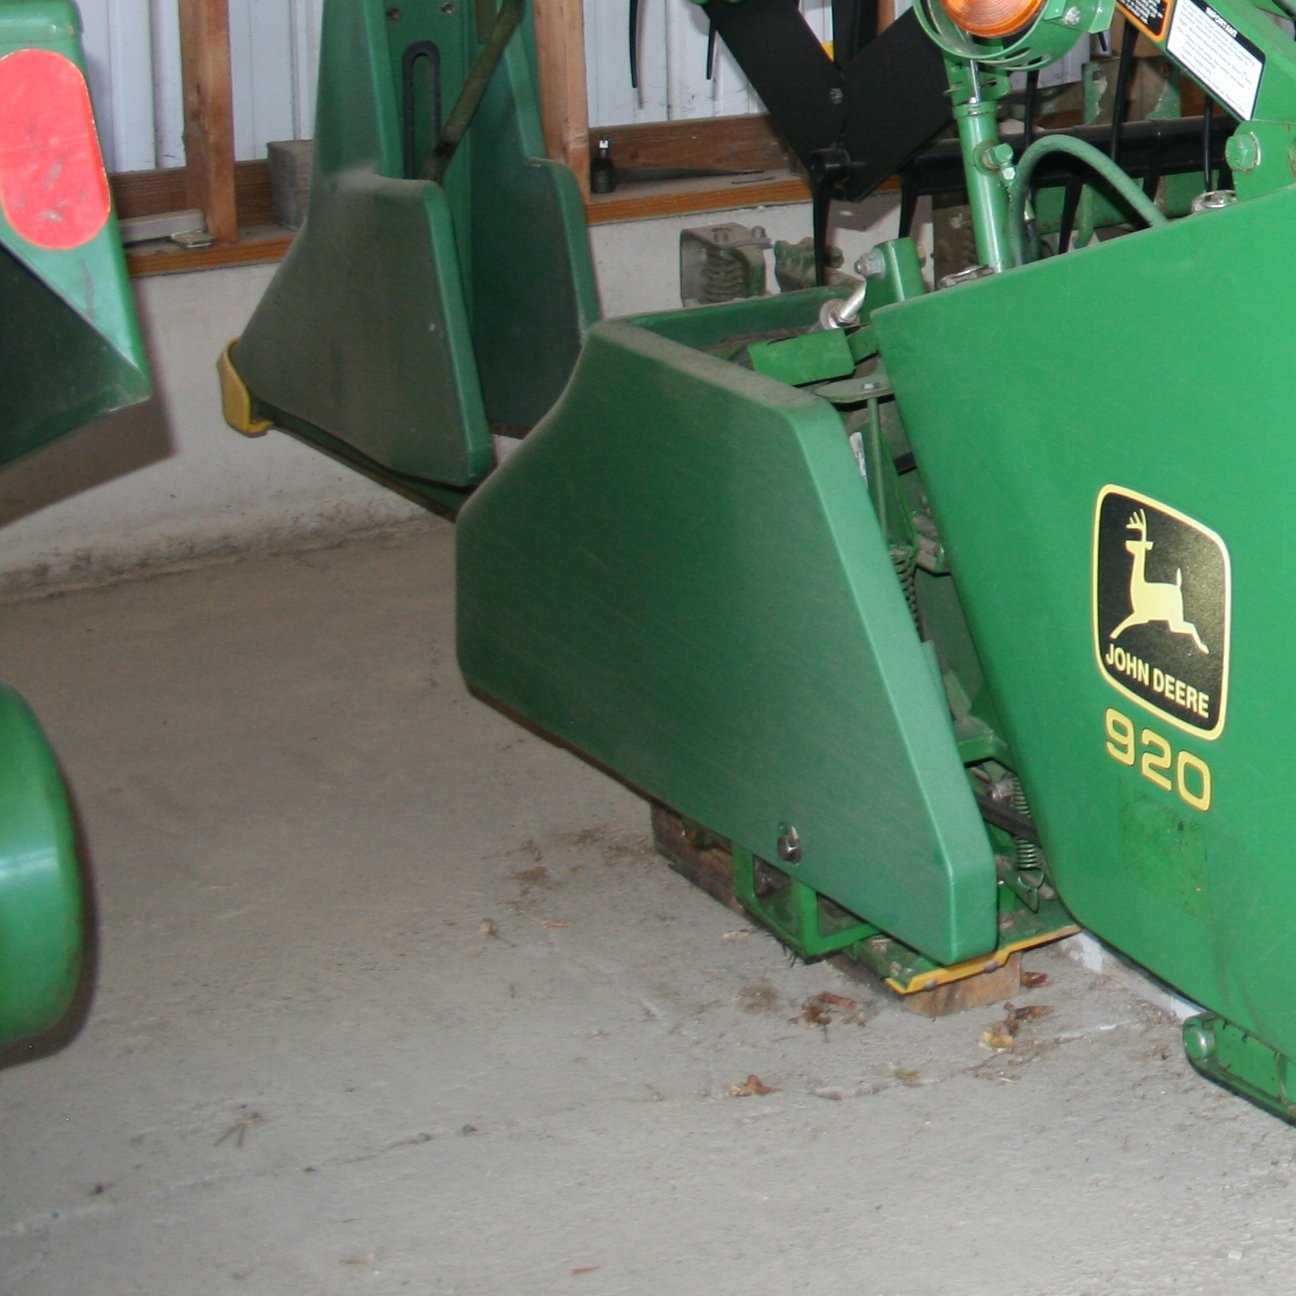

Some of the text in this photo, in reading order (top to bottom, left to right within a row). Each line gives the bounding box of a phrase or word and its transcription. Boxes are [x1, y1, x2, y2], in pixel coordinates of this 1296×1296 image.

[1105, 643, 1210, 719] JOHN DEERE
[1105, 707, 1212, 813] 920
